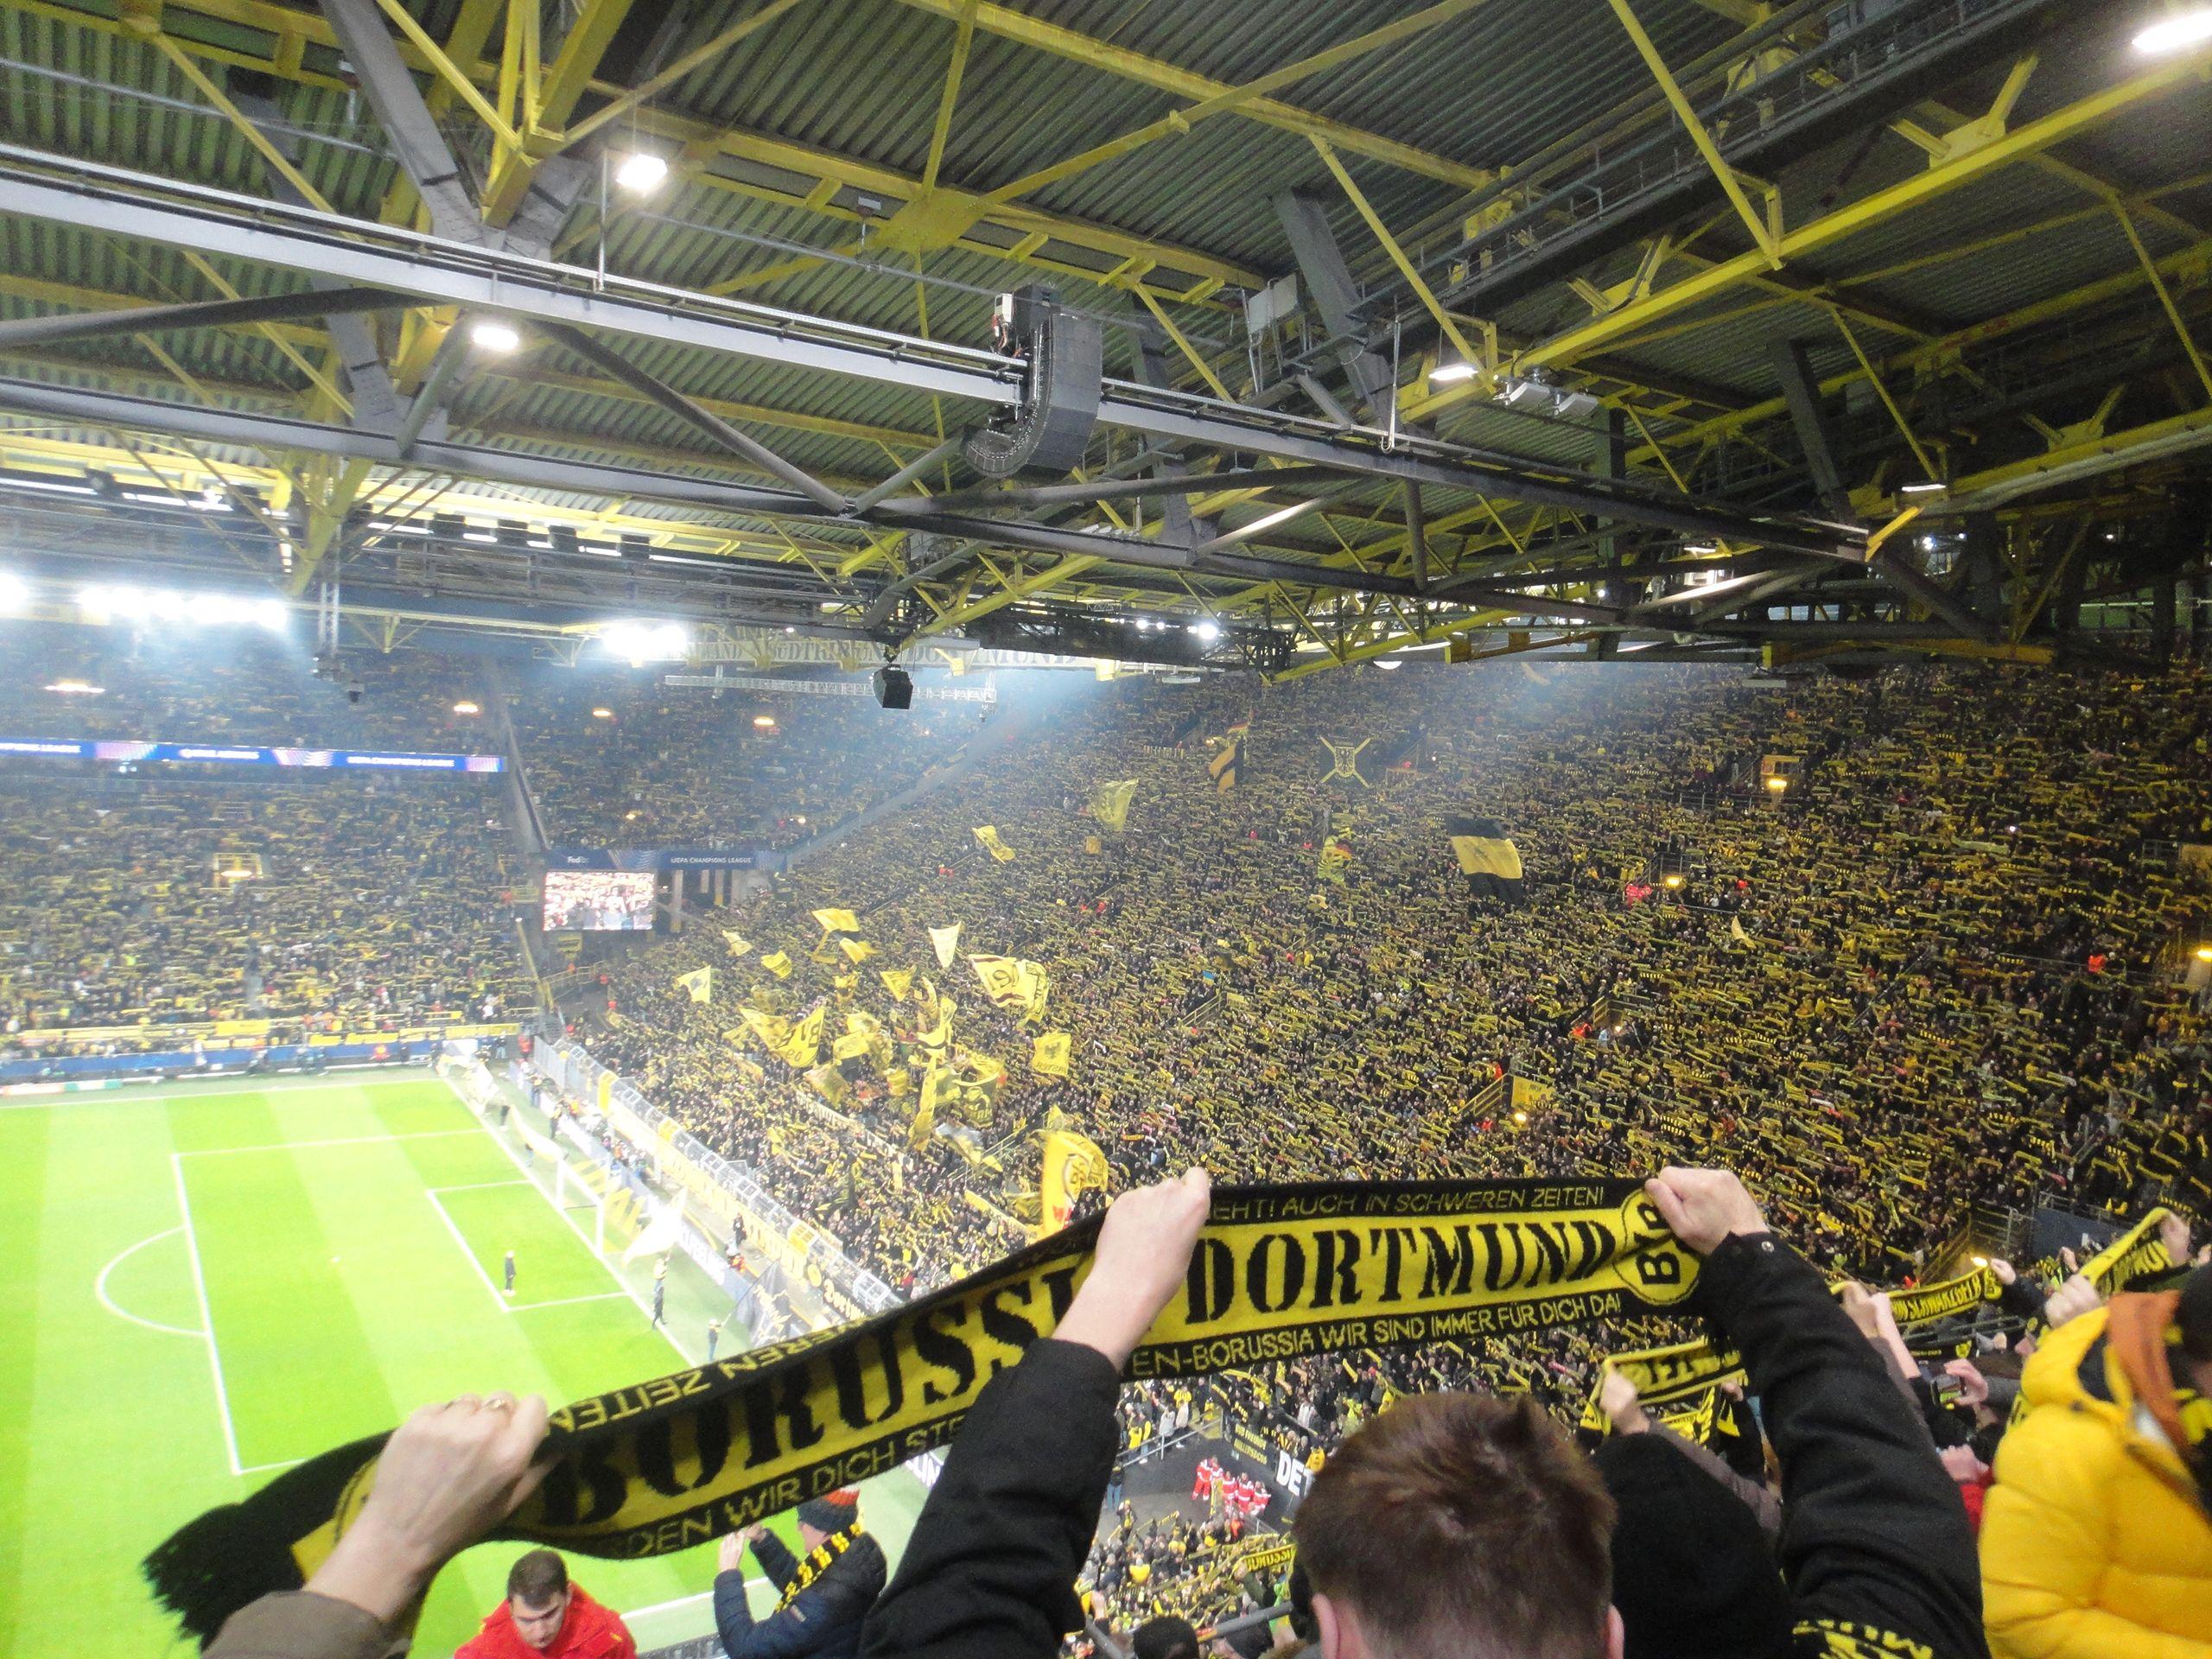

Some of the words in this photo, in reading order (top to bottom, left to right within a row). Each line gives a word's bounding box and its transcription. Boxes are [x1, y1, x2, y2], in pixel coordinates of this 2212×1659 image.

[1282, 1194, 1357, 1216] AUCH
[1365, 1194, 1391, 1211] IN
[1394, 1189, 1526, 1212] SCHWEREN
[1530, 1185, 1605, 1207] ZEITEN!
[544, 1264, 1077, 1528] BORUSSI
[1185, 1219, 1617, 1325] DORTMUND
[724, 1477, 804, 1527] WIR
[812, 1441, 895, 1497] DICH
[1319, 1322, 1368, 1350] WIR
[1373, 1316, 1426, 1344] SIND
[1430, 1307, 1497, 1338] IMMER
[1497, 1301, 1539, 1330] FÜR
[1539, 1296, 1587, 1325] DICH
[1589, 1293, 1621, 1317] DA!
